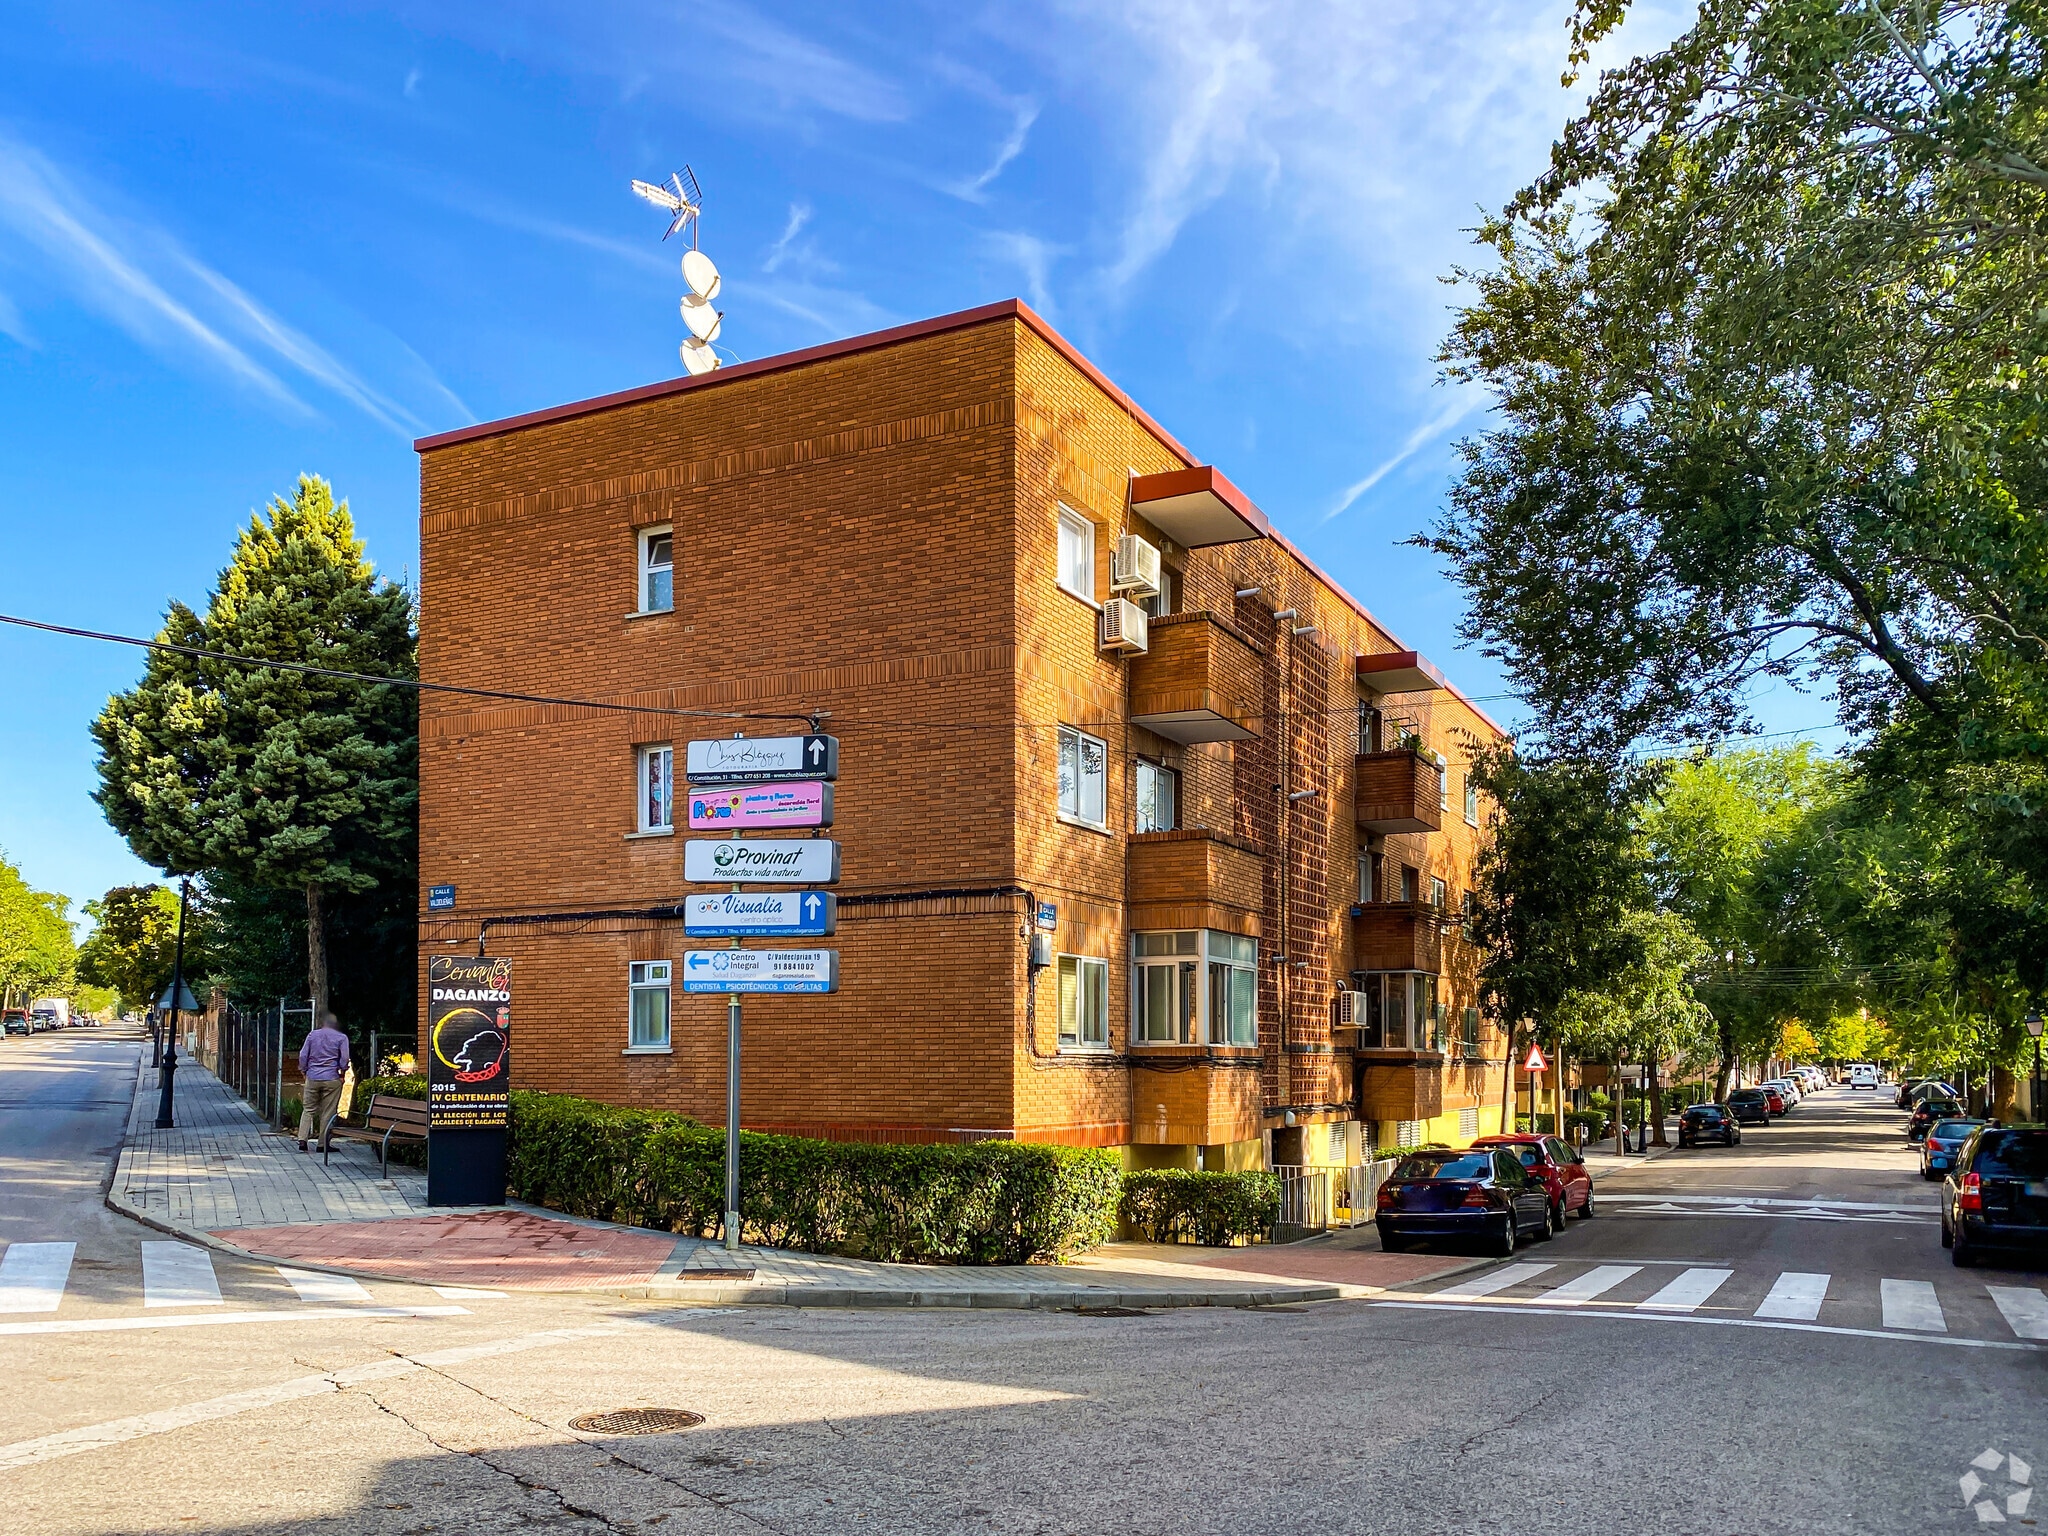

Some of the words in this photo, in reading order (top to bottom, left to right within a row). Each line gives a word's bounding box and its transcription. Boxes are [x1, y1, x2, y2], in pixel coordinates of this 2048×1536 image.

[734, 847, 803, 864] Provinat
[713, 868, 754, 876] Productos
[754, 867, 771, 876] vida
[772, 868, 802, 876] natural
[722, 895, 784, 914] Visualia
[430, 958, 512, 989] Cervantes
[730, 962, 759, 970] Integral
[493, 974, 510, 992] en
[726, 982, 778, 990] PSICOTÉCNICOS
[432, 988, 510, 1001] DAGANZO
